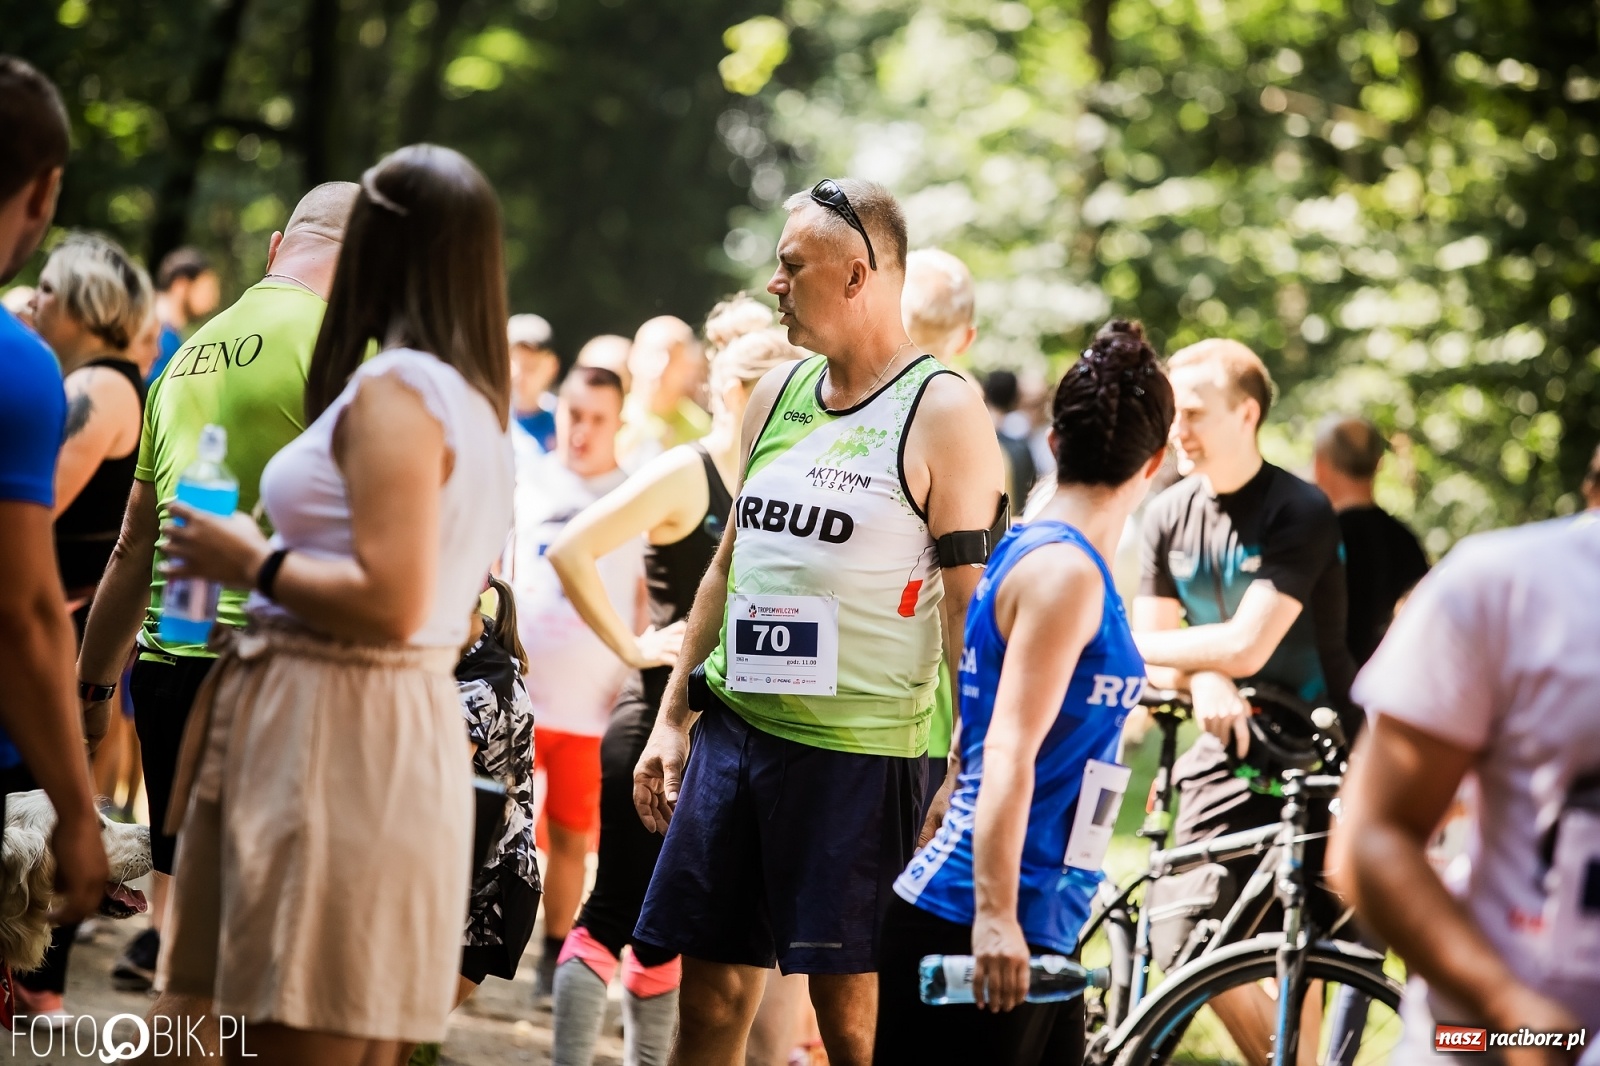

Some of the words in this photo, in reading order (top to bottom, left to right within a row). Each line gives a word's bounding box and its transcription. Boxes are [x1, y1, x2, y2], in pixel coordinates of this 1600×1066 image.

[170, 333, 263, 379] ZENO
[783, 409, 814, 425] deep
[805, 466, 872, 489] AKTYWNI
[812, 479, 854, 494] LYSKI
[752, 624, 791, 652] 70
